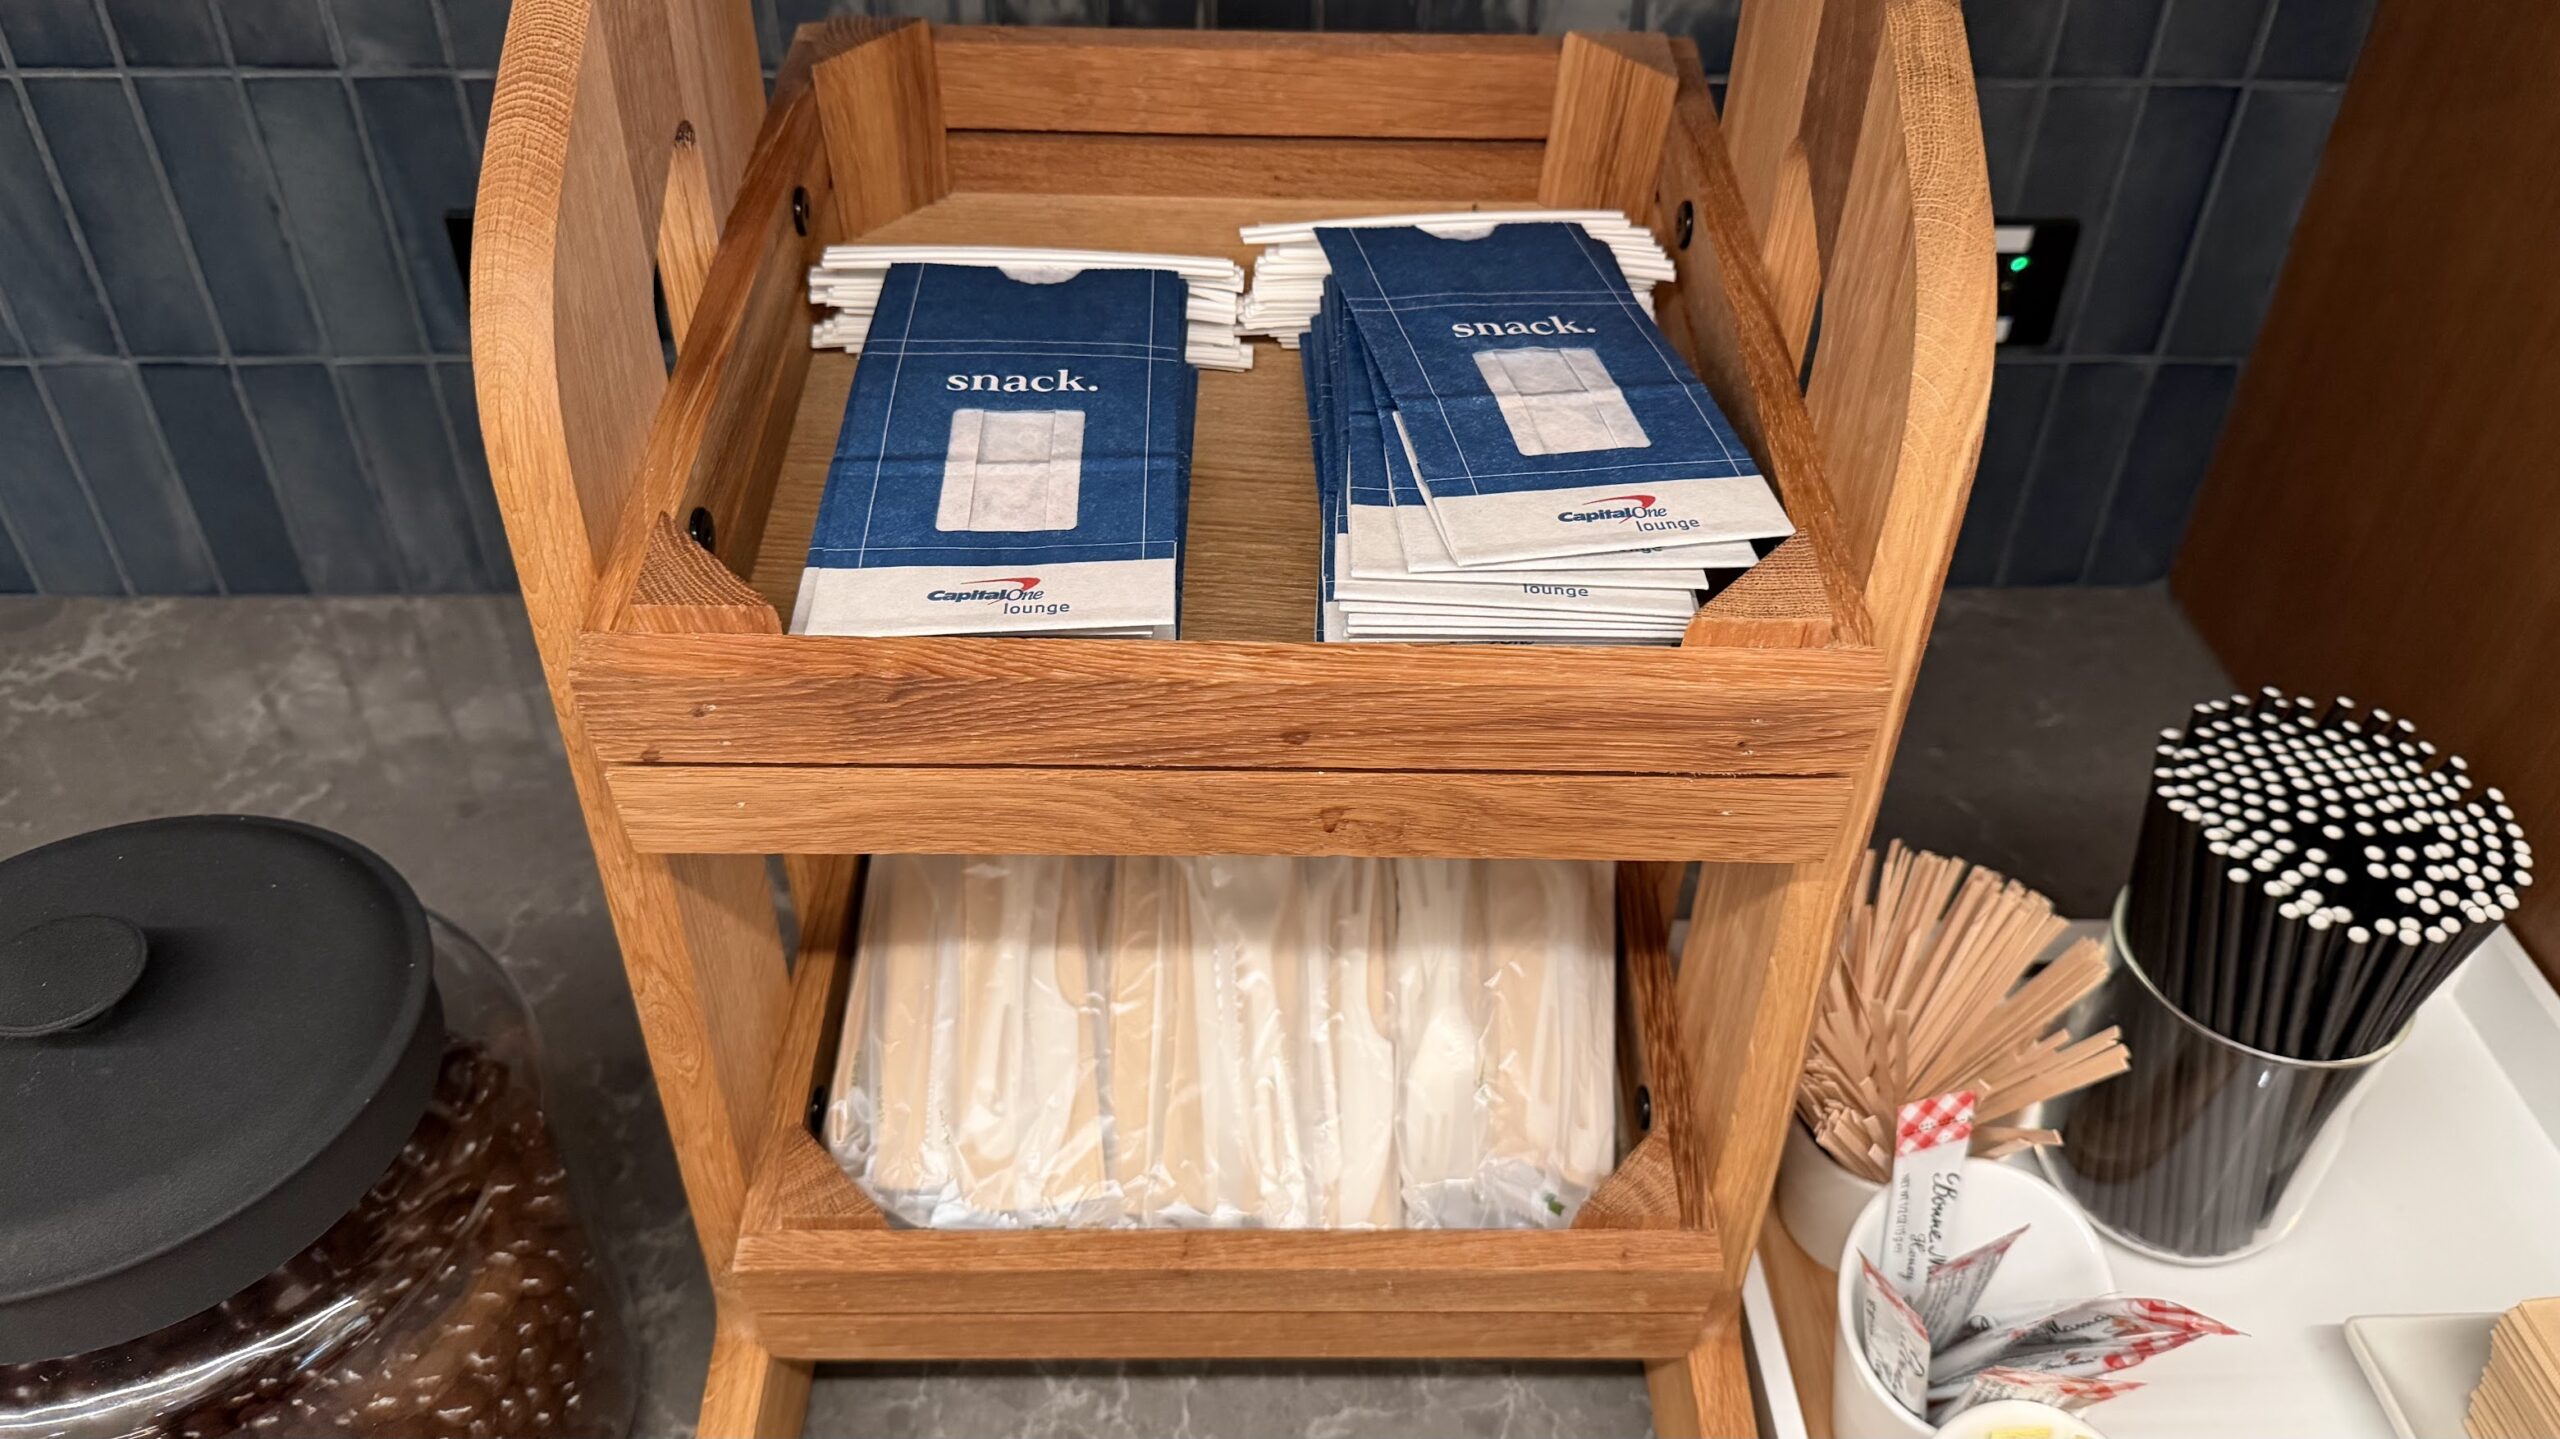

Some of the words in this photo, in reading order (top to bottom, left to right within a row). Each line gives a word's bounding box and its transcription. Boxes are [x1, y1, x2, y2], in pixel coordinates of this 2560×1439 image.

[1451, 315, 1597, 338] snack.
[946, 369, 1099, 393] snack.
[1636, 519, 1701, 532] lounge
[1523, 583, 1589, 598] lounge
[1003, 602, 1071, 615] lounge
[1929, 1173, 1961, 1243] Bonne
[1898, 1233, 1926, 1281] Honey
